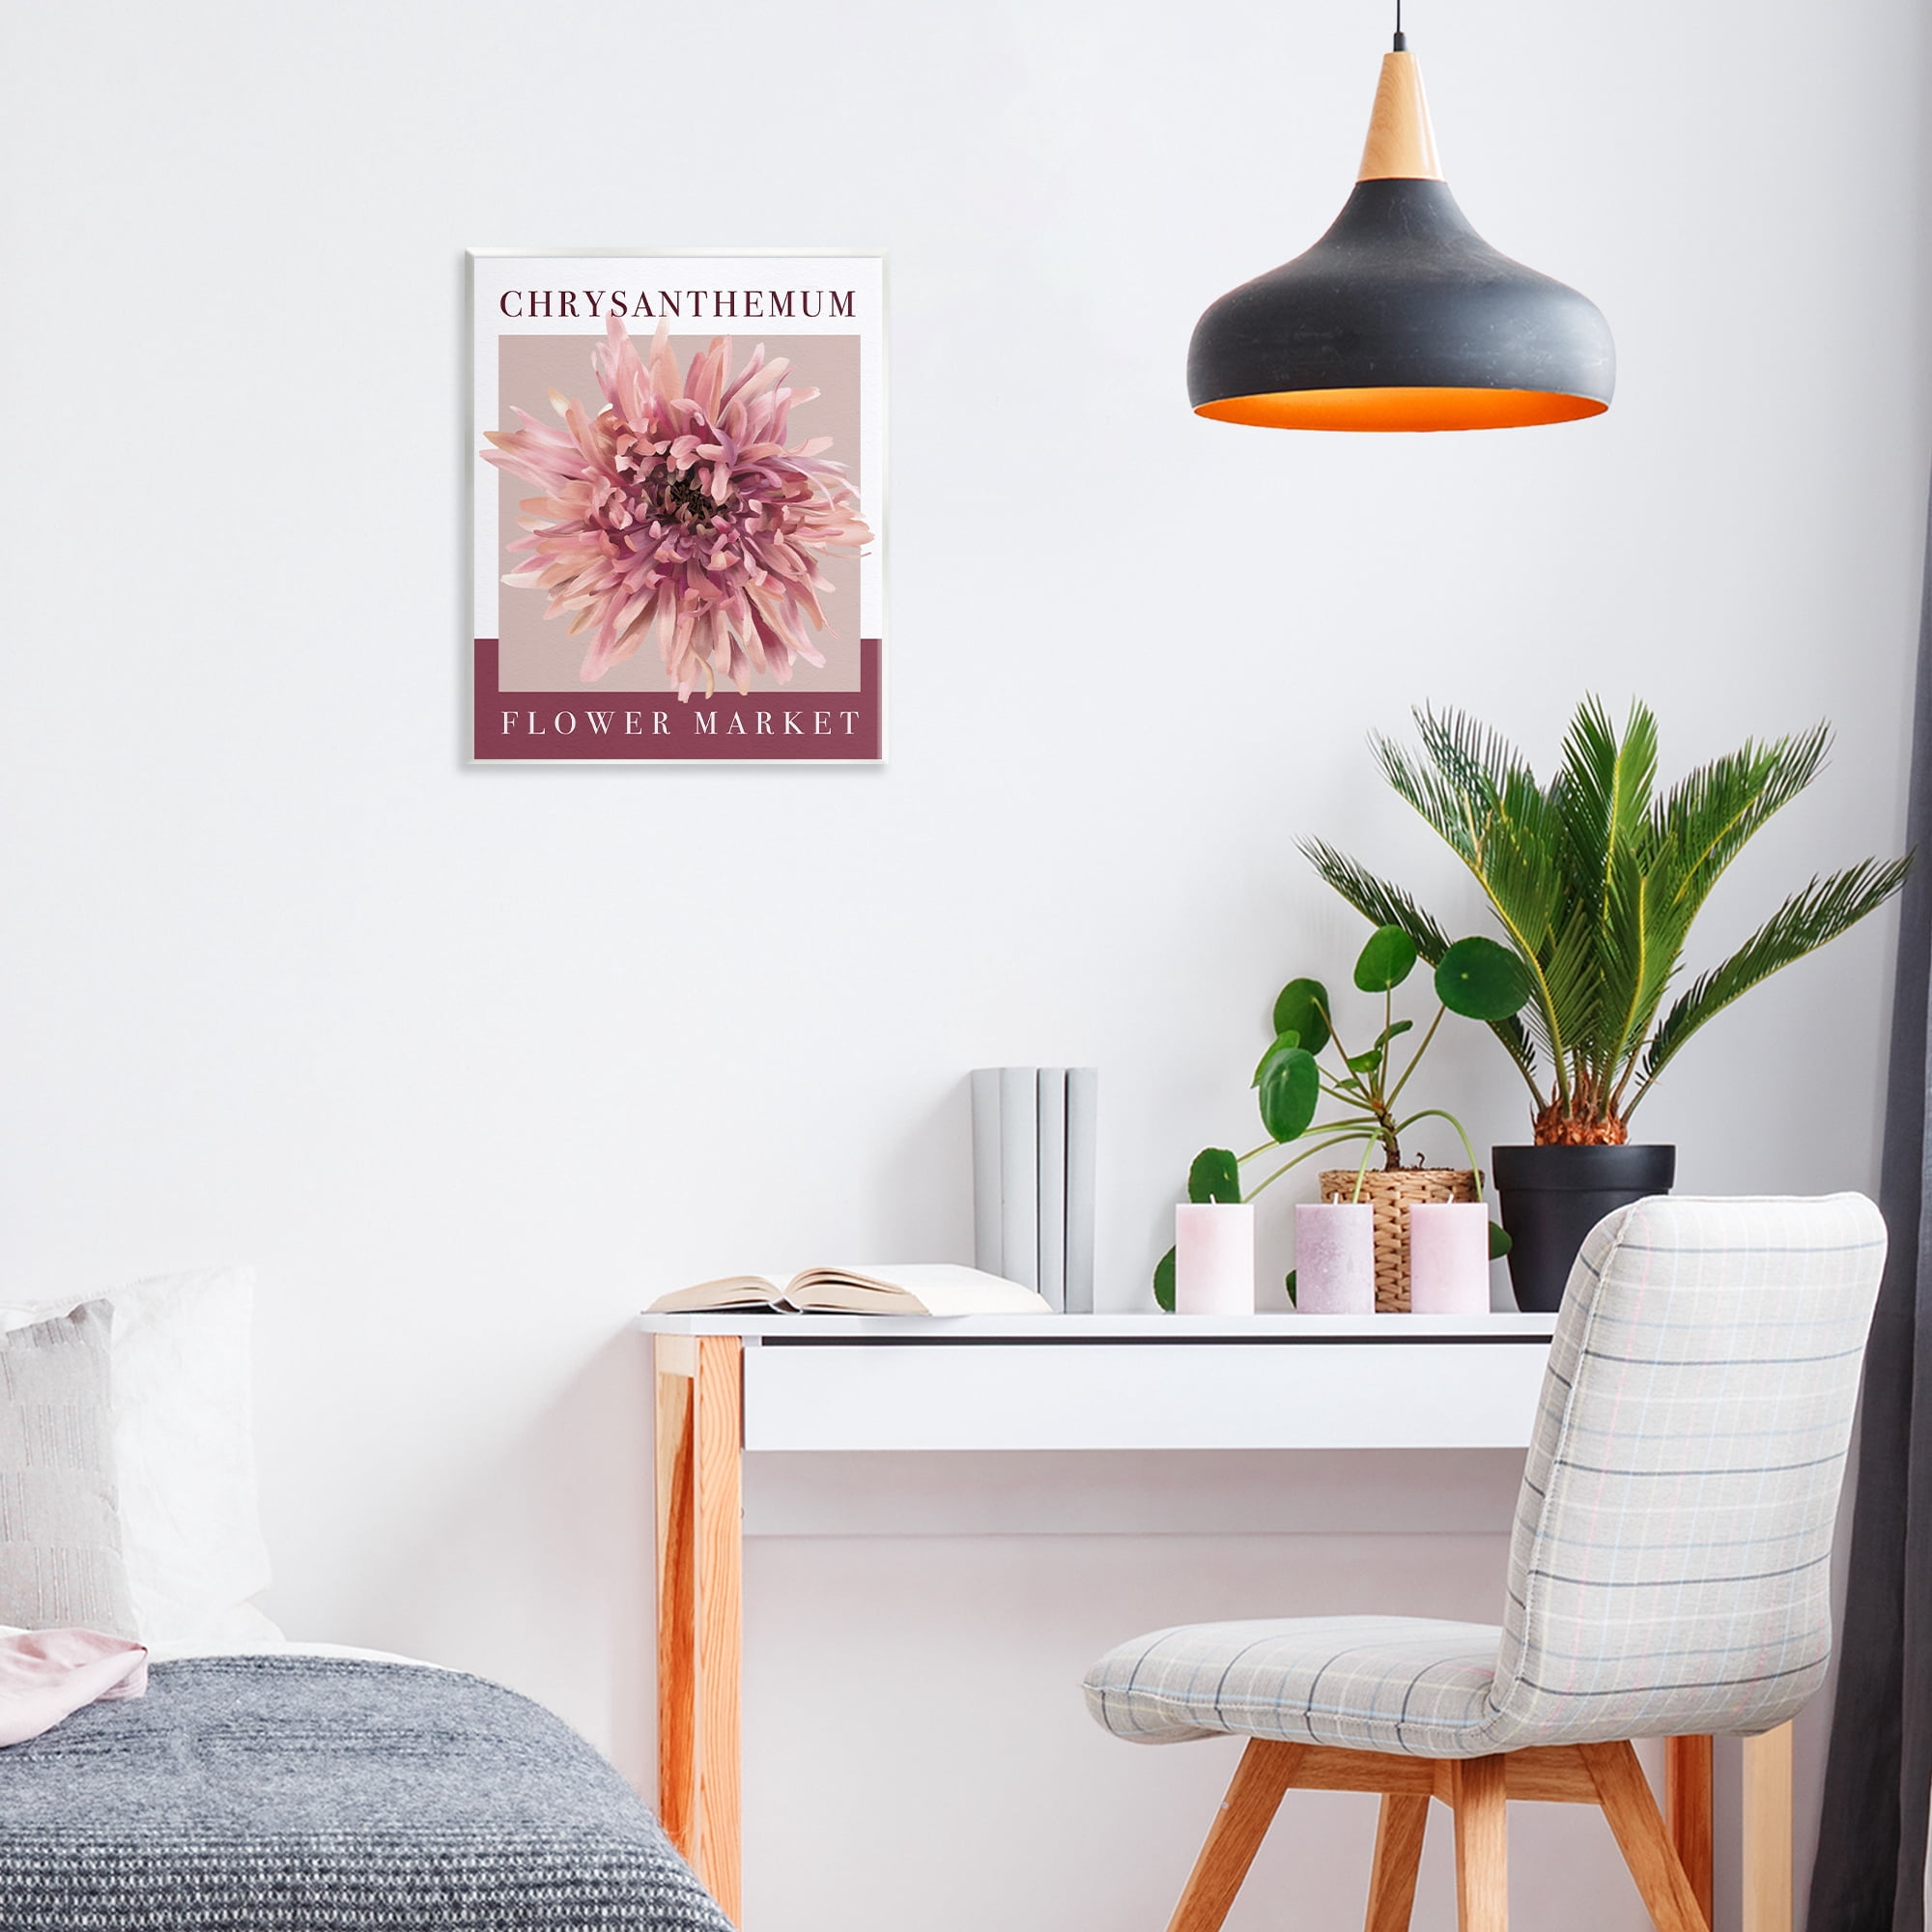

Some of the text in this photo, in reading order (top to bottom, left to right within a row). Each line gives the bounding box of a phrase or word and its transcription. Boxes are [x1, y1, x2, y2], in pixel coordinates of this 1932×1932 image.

[499, 290, 856, 318] CHRYSANTHEMUM
[500, 710, 860, 735] FLOWER MARKET
